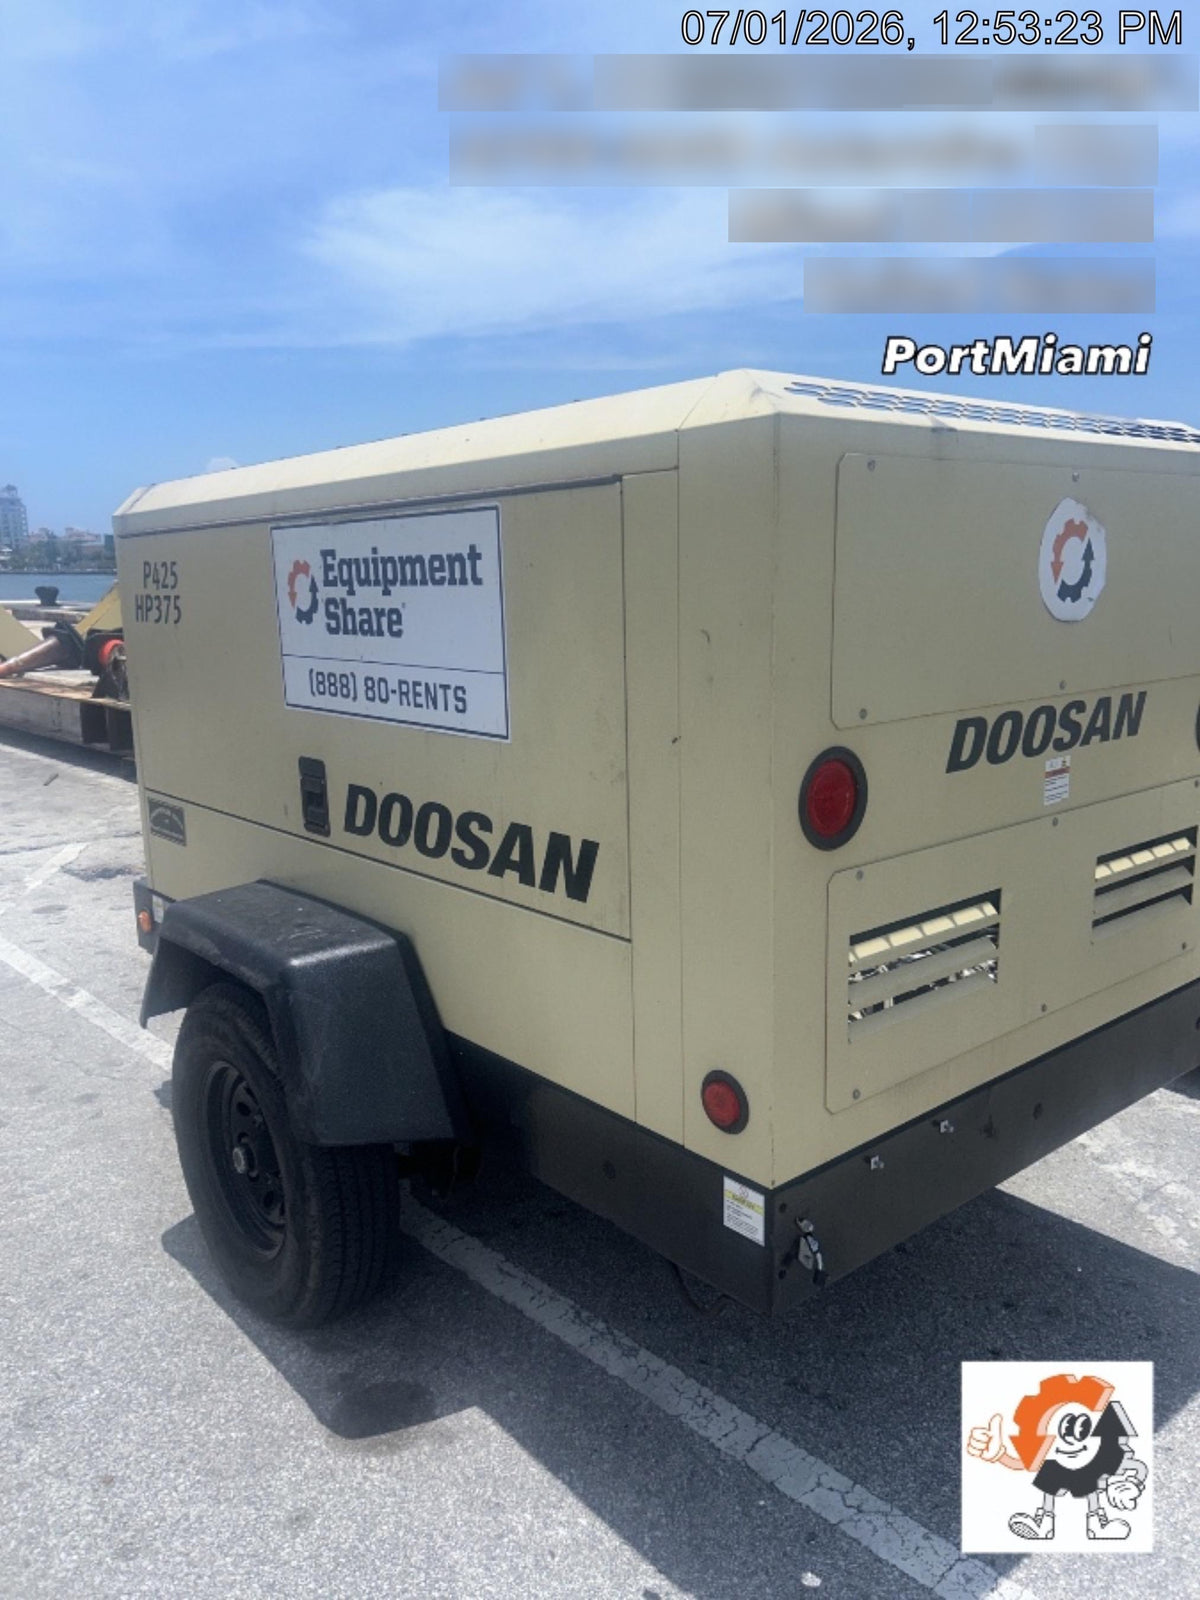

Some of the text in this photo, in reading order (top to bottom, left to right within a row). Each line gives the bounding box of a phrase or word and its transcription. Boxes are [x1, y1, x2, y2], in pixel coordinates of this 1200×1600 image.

[143, 560, 179, 591] P425
[320, 544, 483, 597] Equipment
[135, 594, 182, 625] HP375
[309, 668, 468, 715] (888) 80-RENTS
[946, 690, 1147, 774] DOOSAN
[344, 783, 600, 903] DOOSAN
